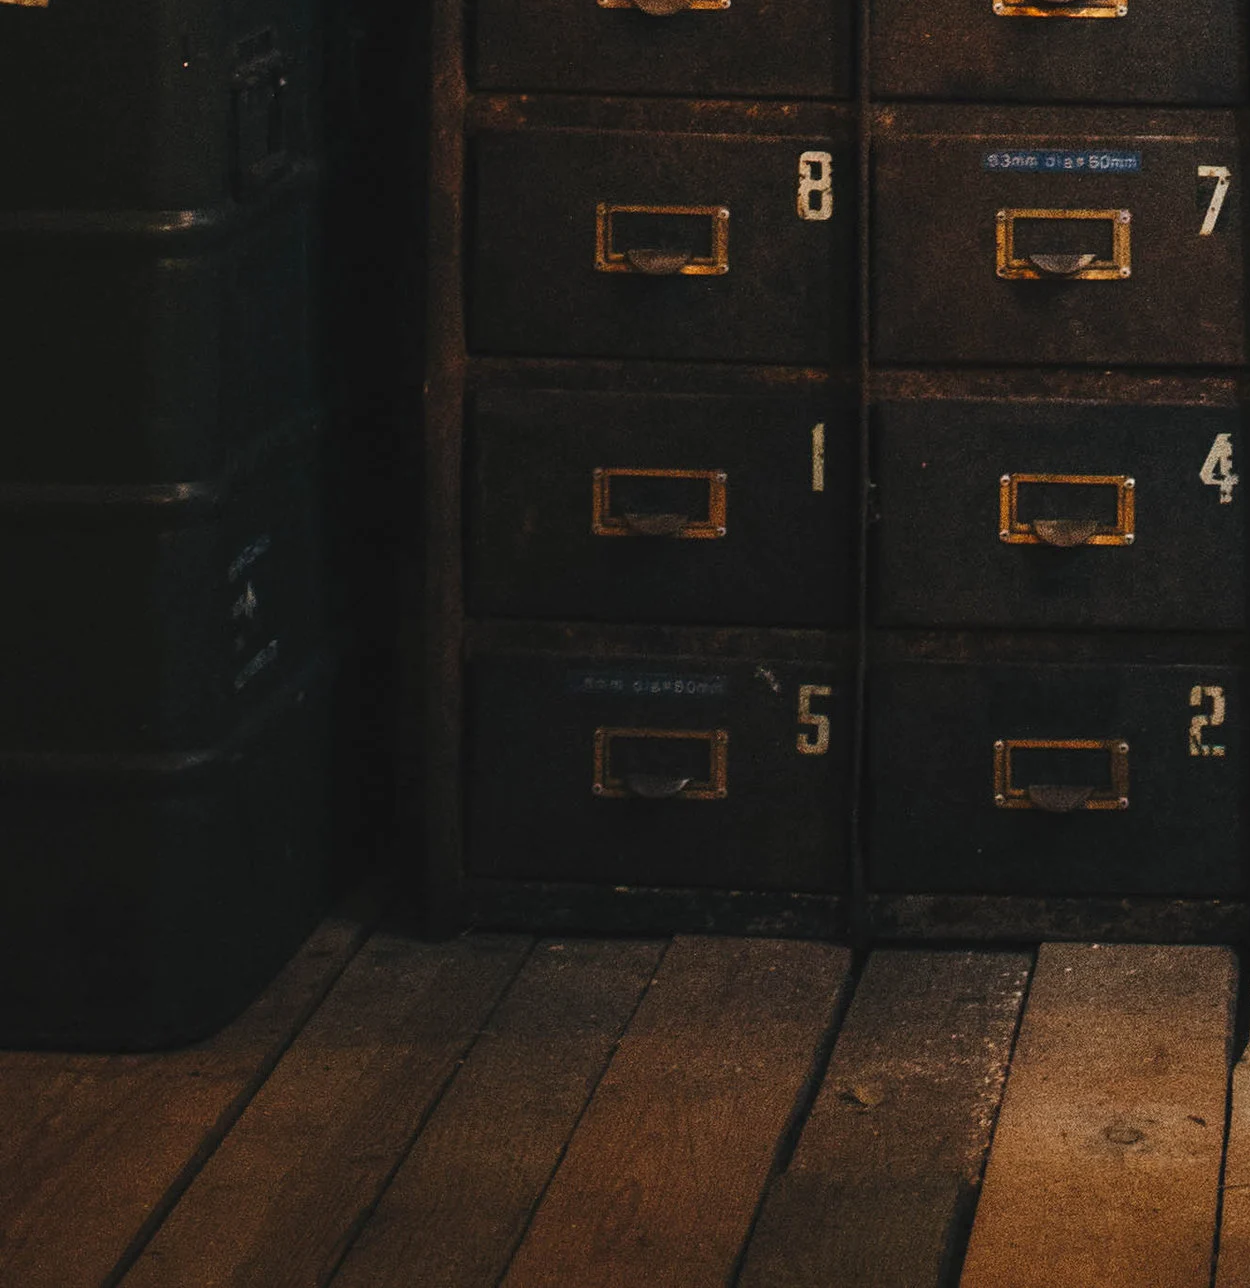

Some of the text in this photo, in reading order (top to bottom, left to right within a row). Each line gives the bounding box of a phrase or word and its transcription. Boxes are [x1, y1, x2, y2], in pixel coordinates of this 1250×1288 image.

[798, 152, 832, 220] 8
[1198, 166, 1230, 235] 7
[812, 424, 824, 491] 1
[1200, 434, 1237, 503] 4
[797, 685, 830, 753] 5
[1190, 686, 1225, 755] 2
